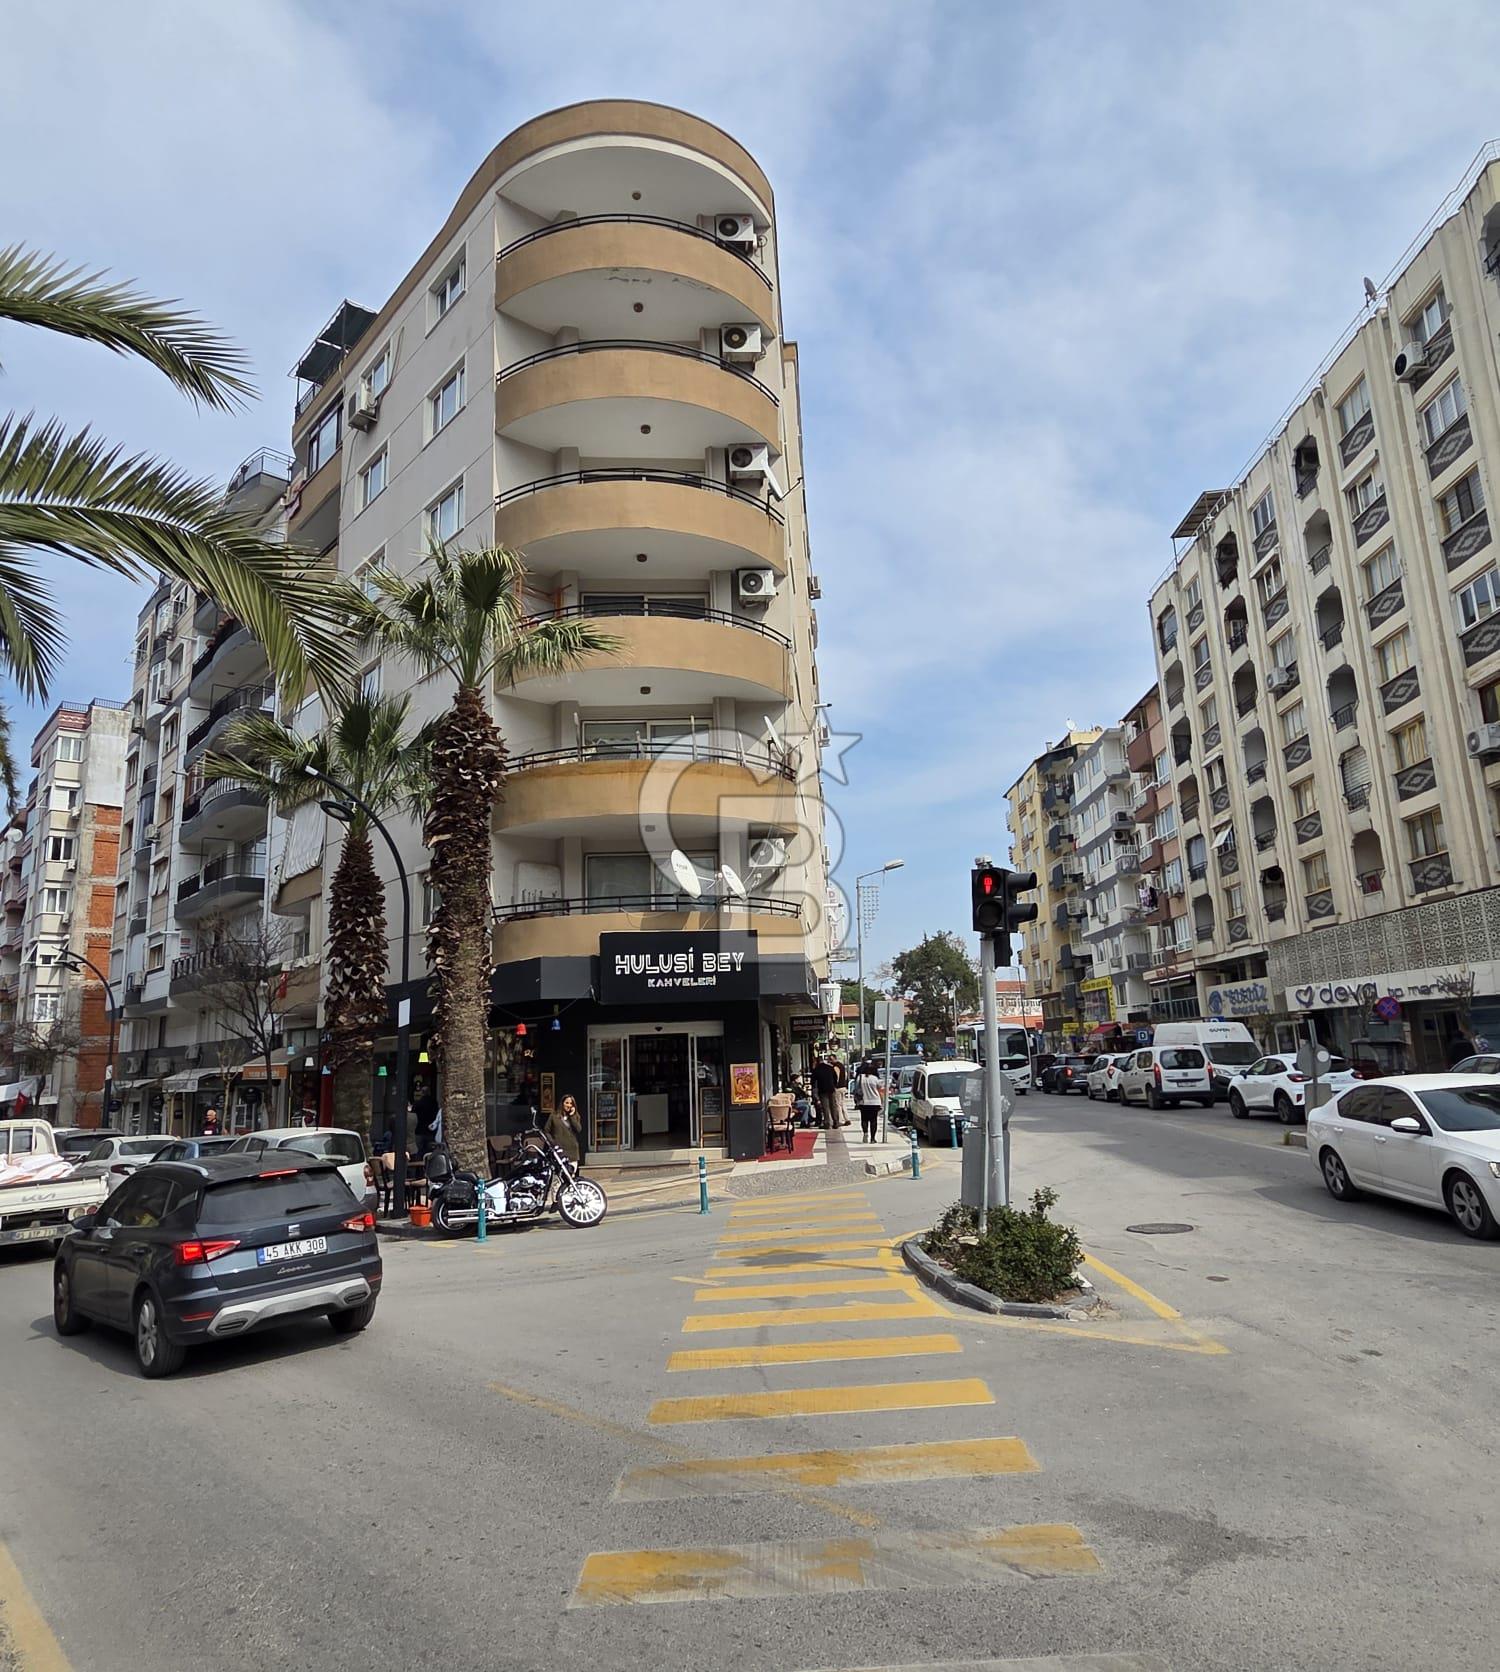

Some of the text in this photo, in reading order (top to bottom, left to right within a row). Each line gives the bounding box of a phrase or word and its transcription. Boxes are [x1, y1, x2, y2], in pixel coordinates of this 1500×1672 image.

[615, 947, 745, 975] HULUSİ BEY
[647, 975, 717, 987] KAHVELERİ
[266, 1238, 324, 1258] 45 AKK 308
